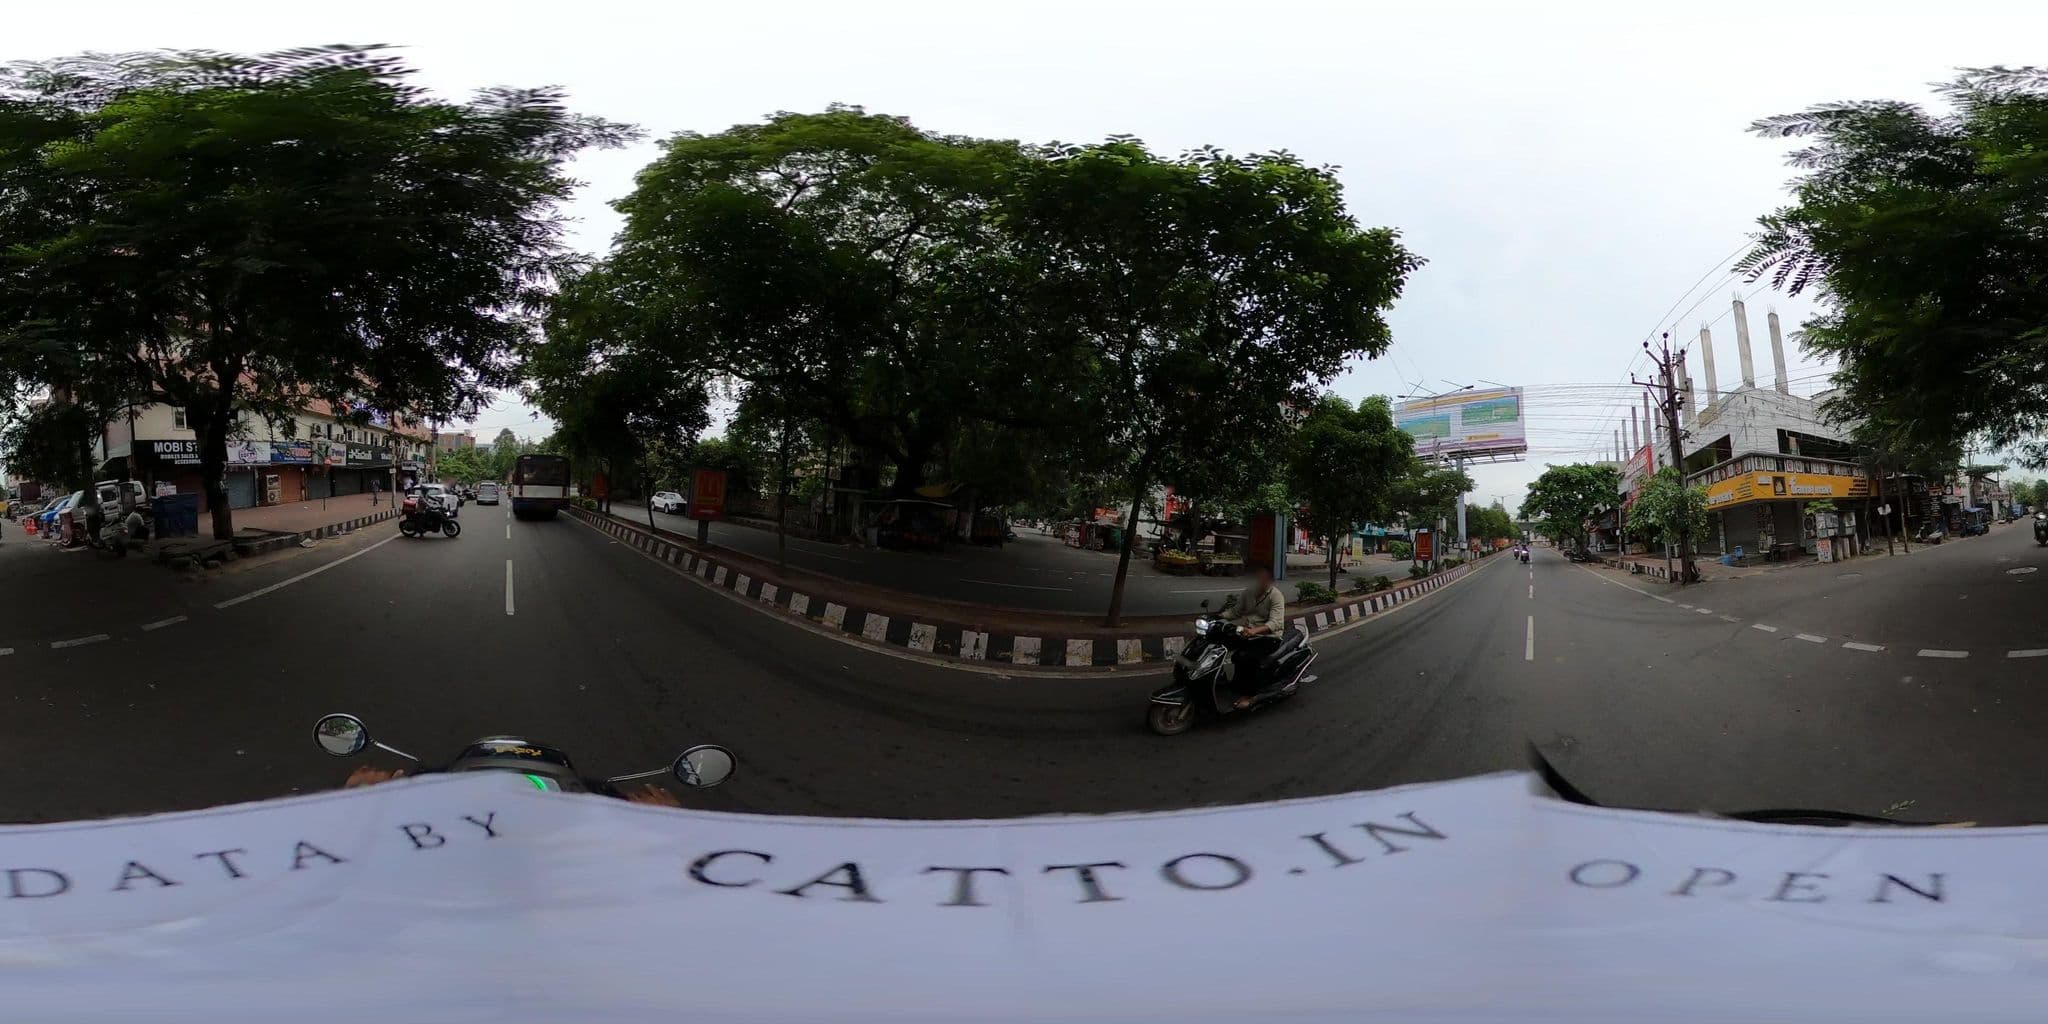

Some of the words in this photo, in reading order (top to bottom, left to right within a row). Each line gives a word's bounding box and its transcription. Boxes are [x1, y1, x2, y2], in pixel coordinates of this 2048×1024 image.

[154, 442, 183, 453] MOBI
[5, 840, 350, 900] DATA
[398, 811, 502, 850] BY
[686, 810, 1448, 907] CATTO.IN
[1568, 858, 1948, 904] OPEN
